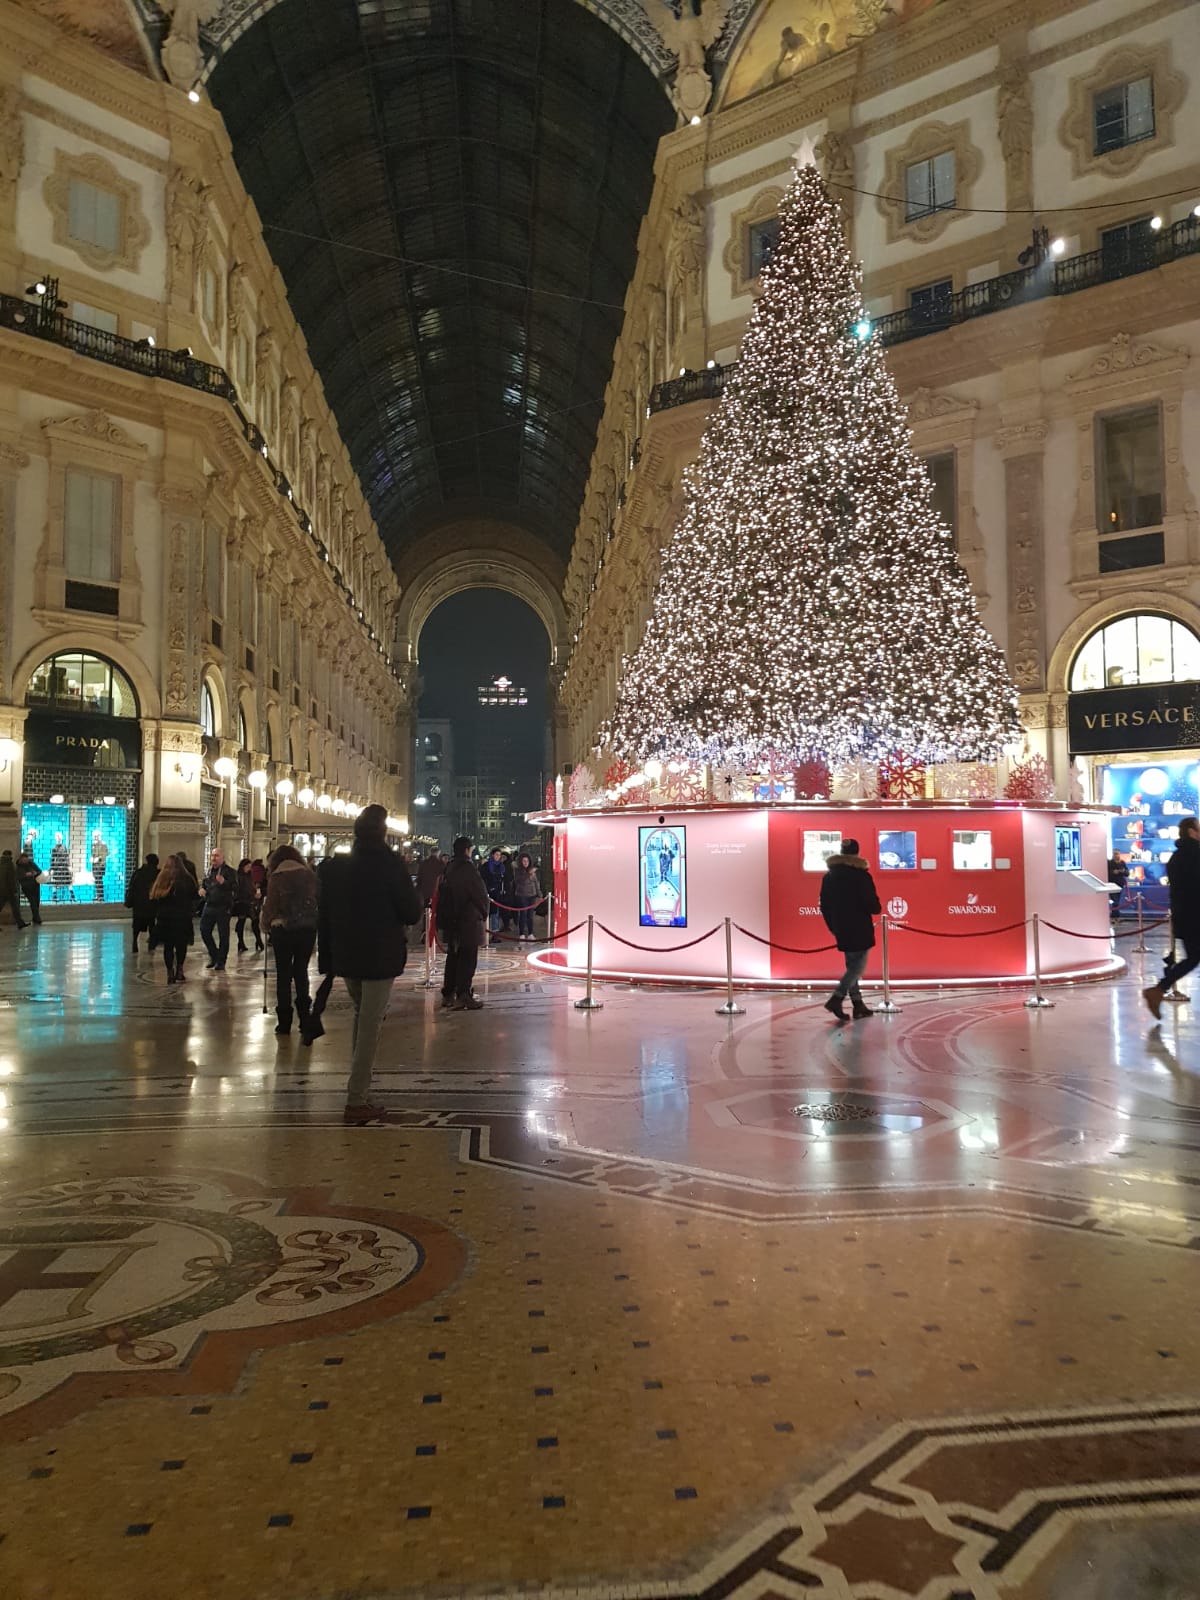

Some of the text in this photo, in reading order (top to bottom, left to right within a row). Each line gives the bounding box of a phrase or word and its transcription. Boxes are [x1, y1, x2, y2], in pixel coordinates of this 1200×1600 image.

[1084, 706, 1194, 729] VERSACE
[55, 736, 110, 749] PRADA
[948, 905, 997, 914] SWAROVSKI
